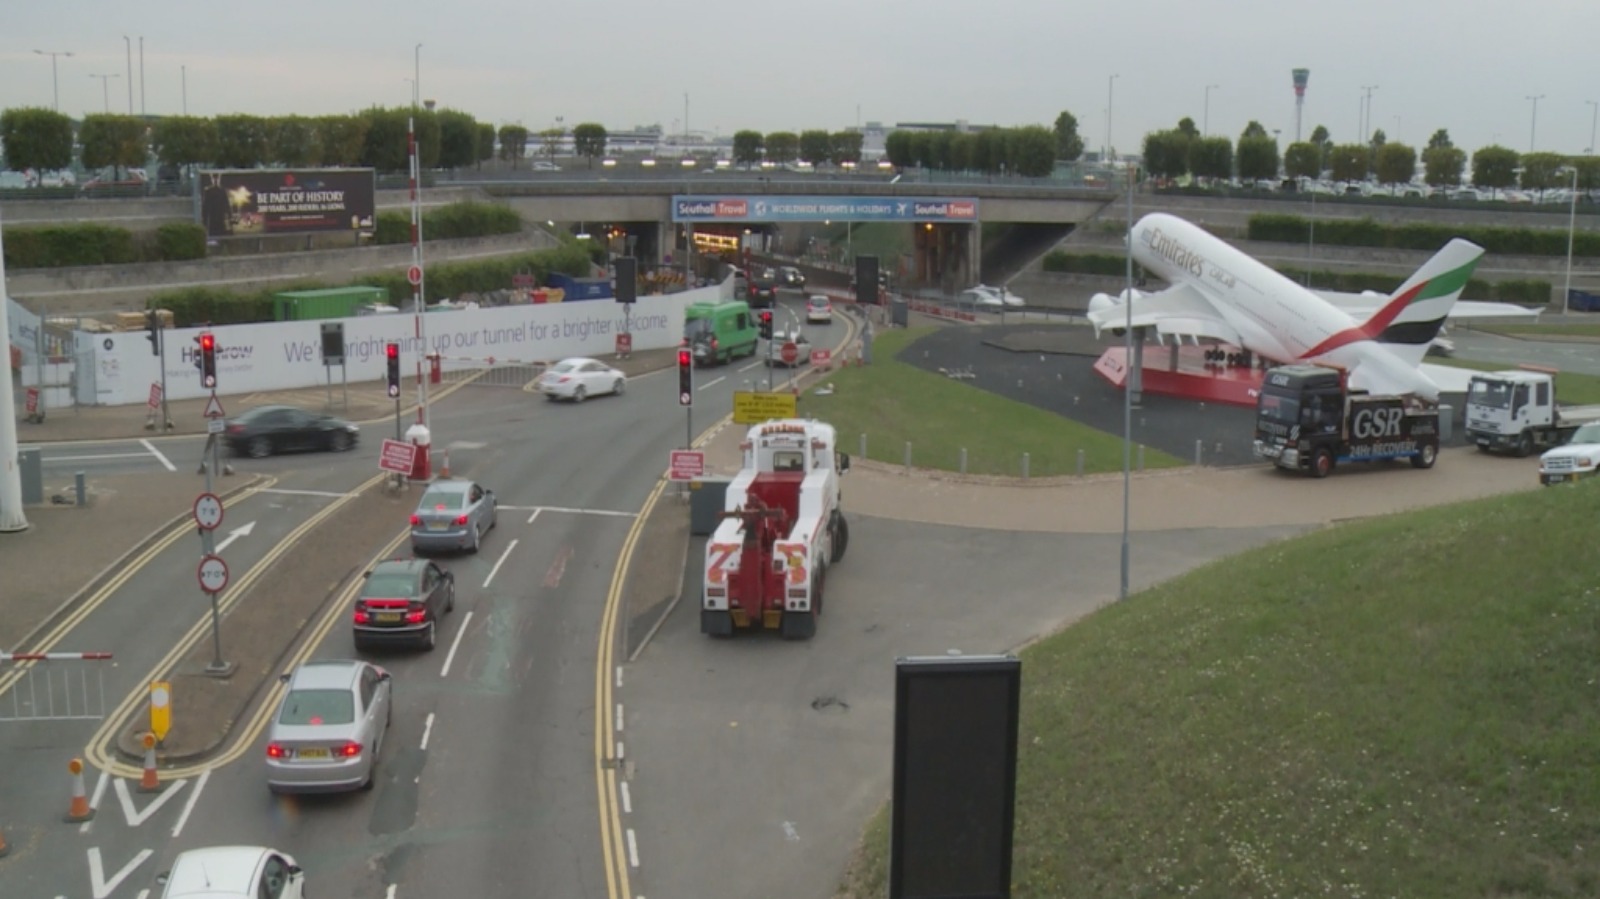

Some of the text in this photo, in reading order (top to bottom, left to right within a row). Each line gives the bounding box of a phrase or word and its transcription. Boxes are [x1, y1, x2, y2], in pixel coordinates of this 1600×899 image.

[257, 190, 344, 204] BE PART OF HISTORY
[679, 203, 746, 215] Southall Travel
[771, 204, 817, 213] WORLDWIDE
[819, 204, 848, 213] FLIGHTS
[857, 204, 891, 213] HOLIDAYS
[915, 203, 975, 216] Southall Travel
[1149, 227, 1203, 278] Emirates
[432, 332, 451, 353] up
[454, 330, 479, 348] our
[483, 321, 526, 345] tunnel
[530, 320, 549, 341] for
[551, 324, 560, 339] a
[563, 317, 612, 342] brighter
[615, 313, 668, 332] welcome
[1271, 374, 1289, 387] GSR
[1353, 407, 1403, 439] GSR
[1372, 441, 1418, 456] RECOVERY
